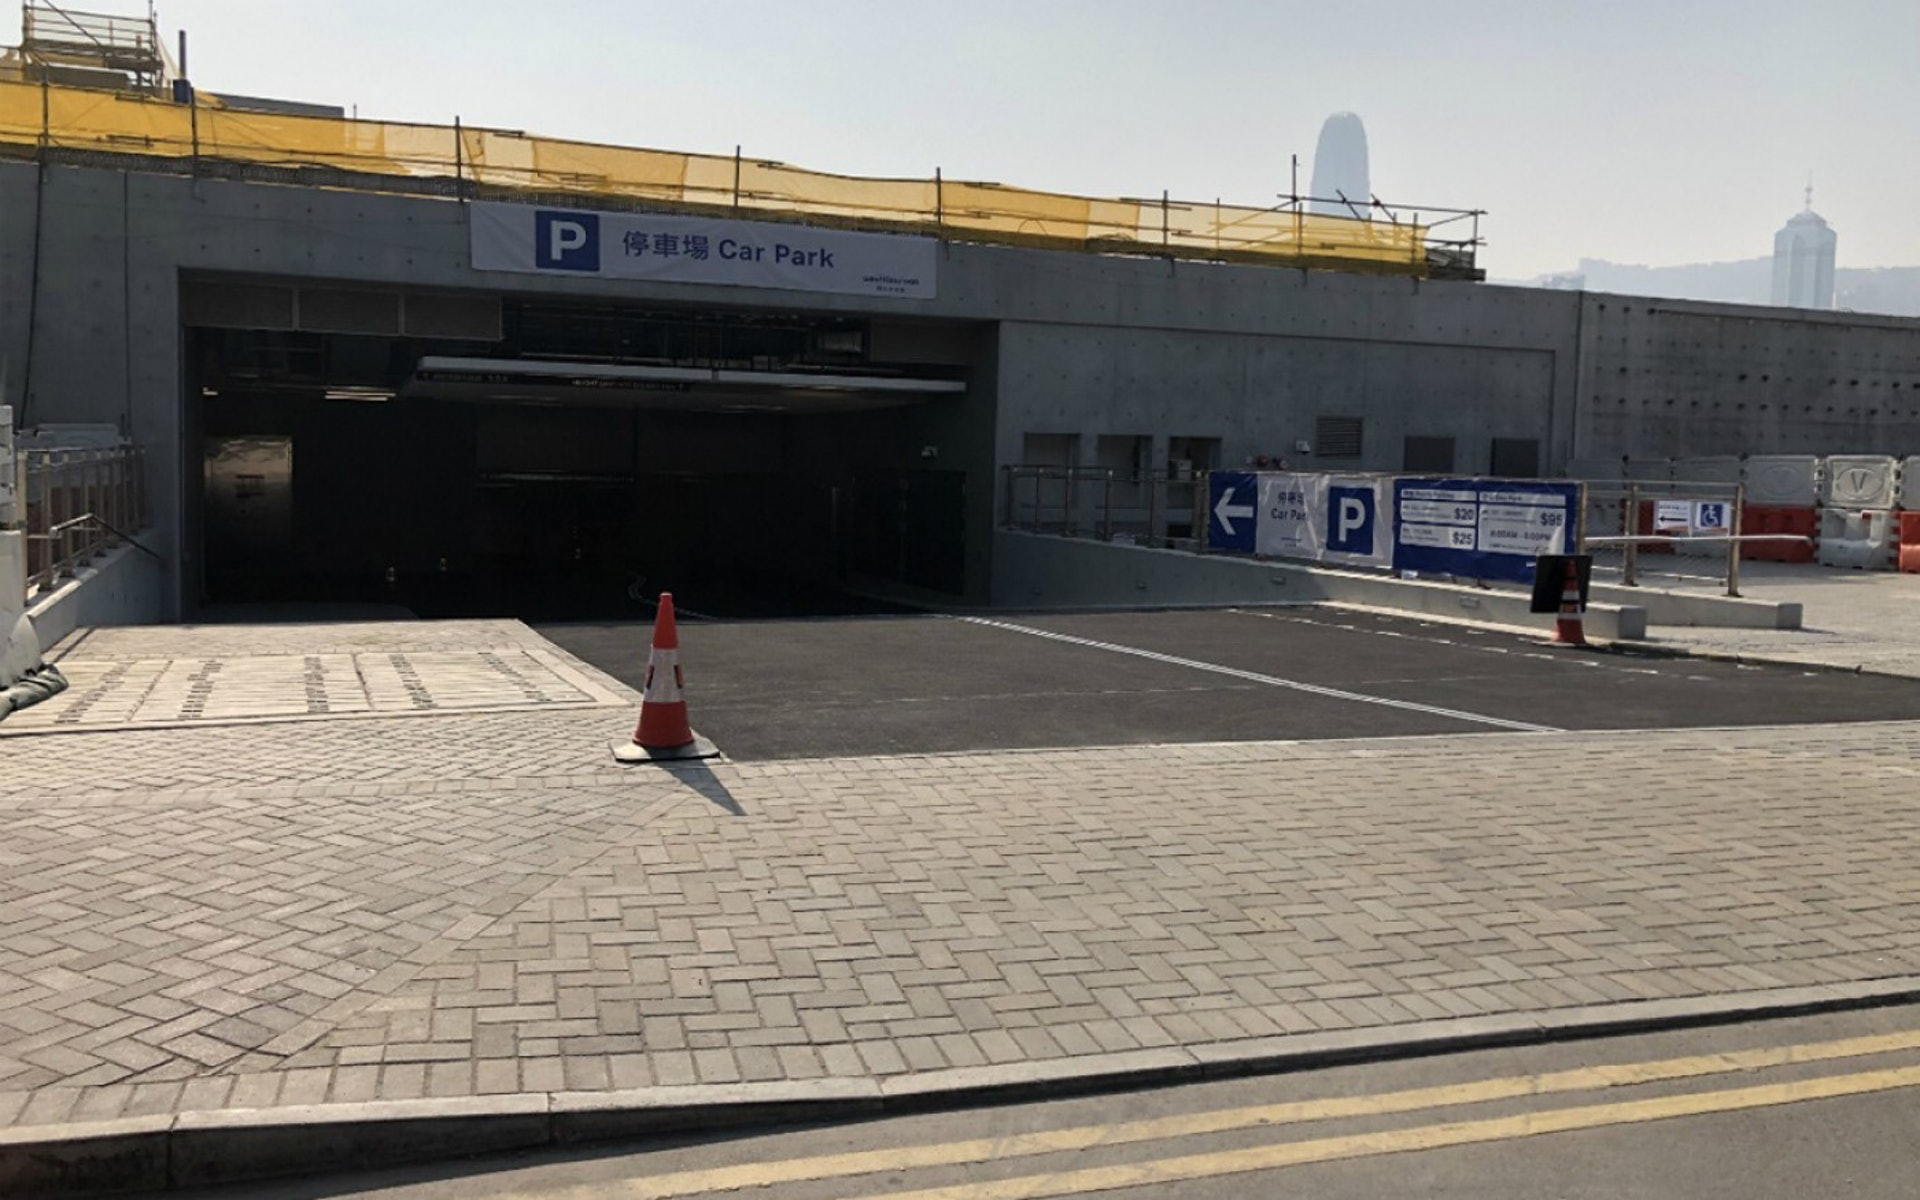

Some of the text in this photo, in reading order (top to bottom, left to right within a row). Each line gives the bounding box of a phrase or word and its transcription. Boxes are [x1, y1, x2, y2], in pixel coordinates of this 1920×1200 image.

[550, 220, 587, 261] P
[622, 230, 834, 269] 停車場 Car Park
[1271, 507, 1307, 521] Car Par
[1338, 497, 1366, 543] P
[1454, 507, 1474, 521] $20
[1540, 512, 1563, 527] $95
[1452, 531, 1473, 546] $25
